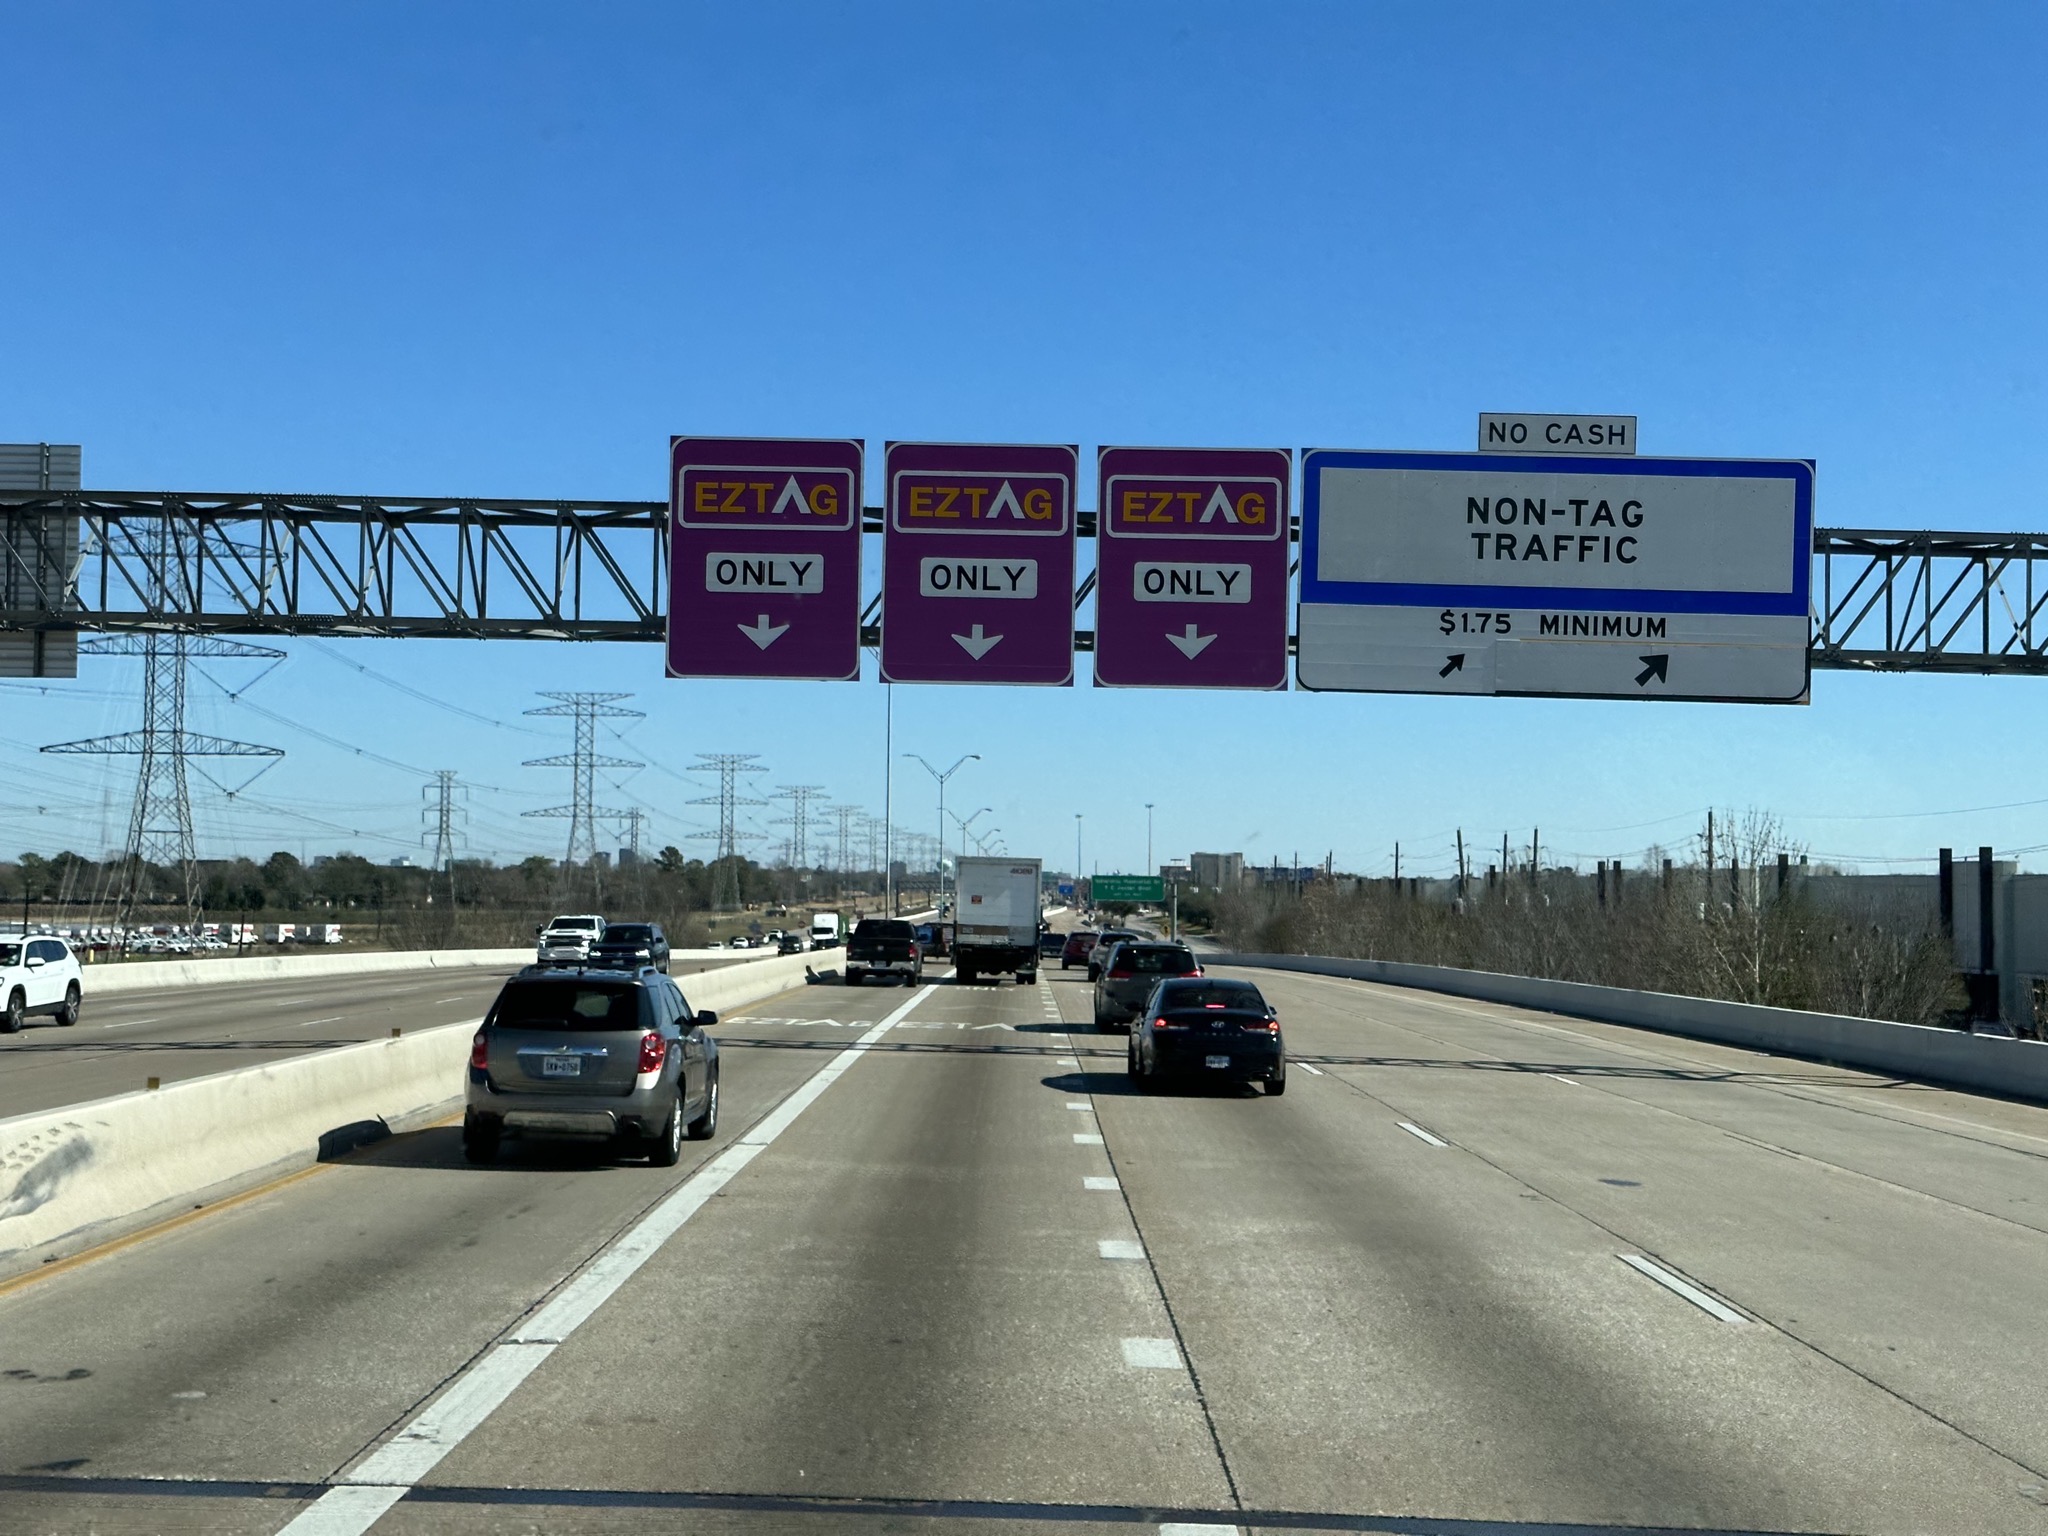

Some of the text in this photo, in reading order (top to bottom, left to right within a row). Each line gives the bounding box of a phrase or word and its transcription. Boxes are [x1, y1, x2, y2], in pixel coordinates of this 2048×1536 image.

[1488, 421, 1626, 446] NO CASH
[694, 474, 838, 515] EZTAG
[910, 479, 1052, 520] EZTAG
[1123, 483, 1265, 524] EZTAG
[1466, 496, 1644, 529] NON-TAG
[1470, 532, 1638, 564] TRAFFIC
[716, 559, 813, 587] ONLY
[930, 564, 1027, 592] ONLY
[1143, 568, 1240, 596] ONLY
[1439, 609, 1667, 639] $1.75 MINIMUM
